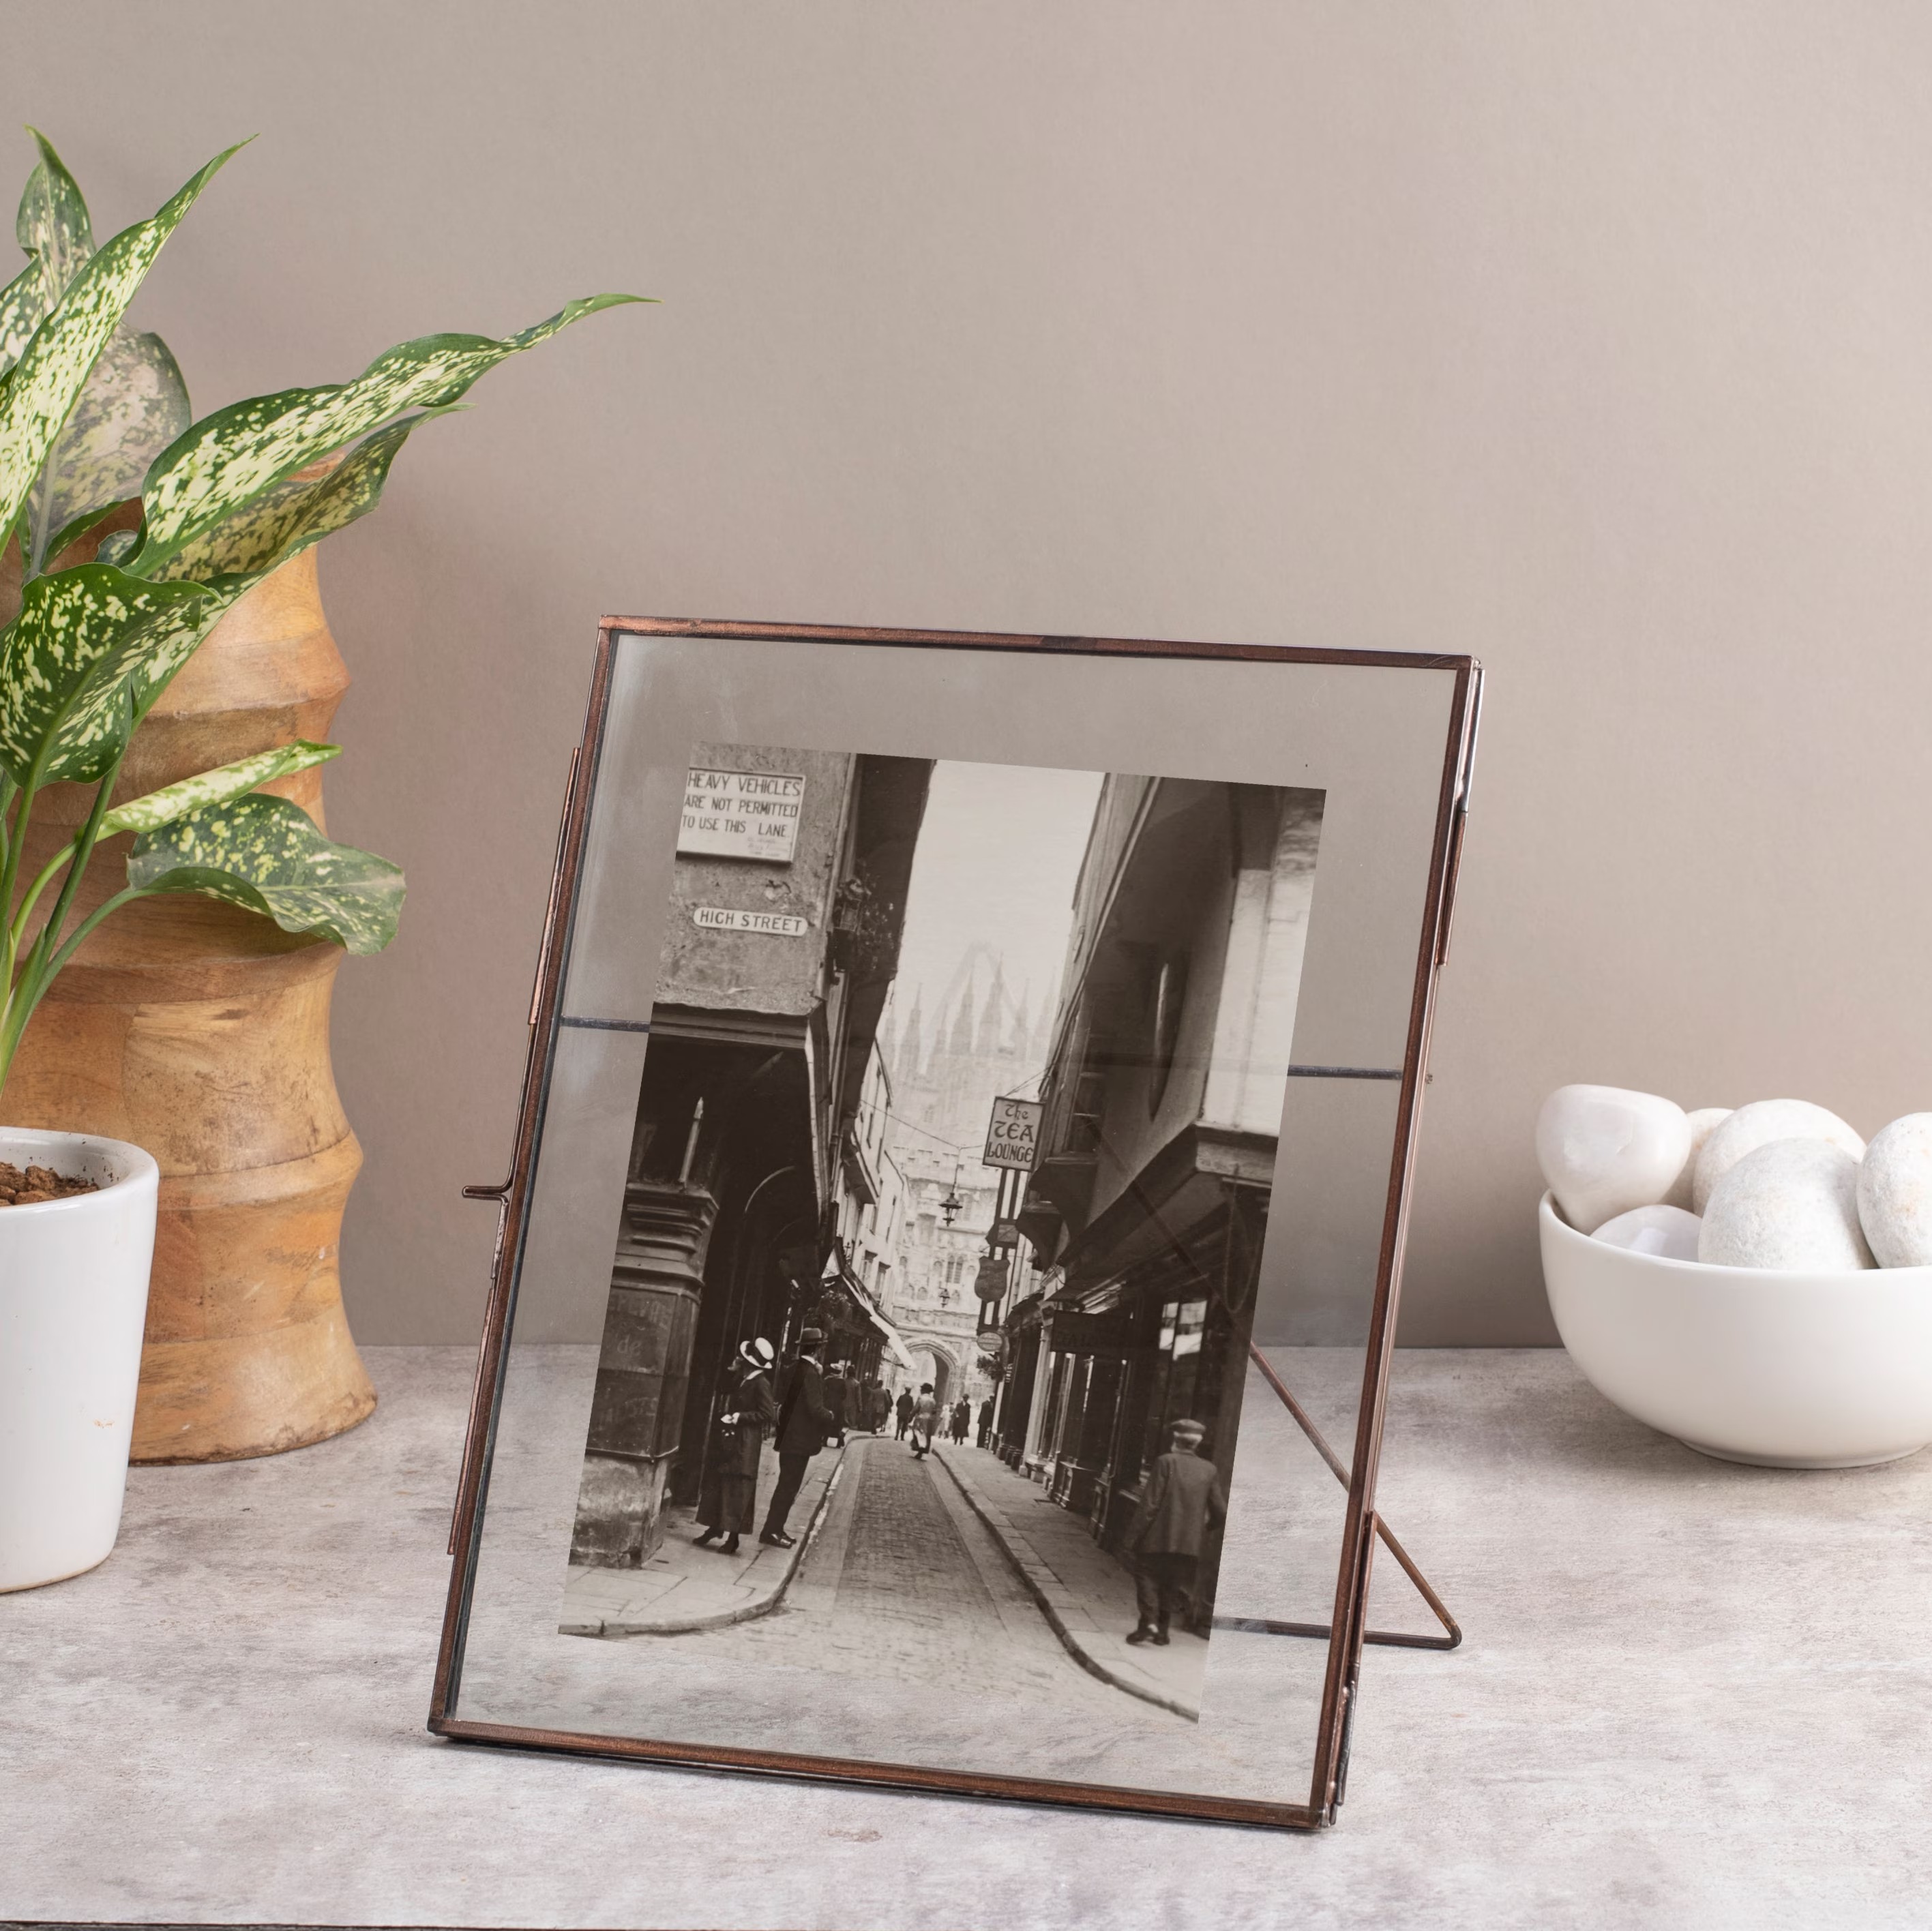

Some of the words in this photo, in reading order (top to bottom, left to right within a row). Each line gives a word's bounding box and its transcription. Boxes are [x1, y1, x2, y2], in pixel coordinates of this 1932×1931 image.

[687, 773, 730, 790] HEAVY
[739, 777, 801, 796] VEHICLES
[684, 794, 706, 808] ARE
[711, 798, 732, 811] NOT
[738, 800, 798, 818] PERMITTED
[682, 815, 695, 828] TO
[699, 816, 719, 830] USE
[724, 819, 746, 833] THIS
[700, 910, 734, 925] HIGH
[741, 914, 802, 932] STREET
[1005, 1104, 1028, 1120] The
[994, 1120, 1034, 1143] TEA
[986, 1141, 1034, 1163] LOUNGE
